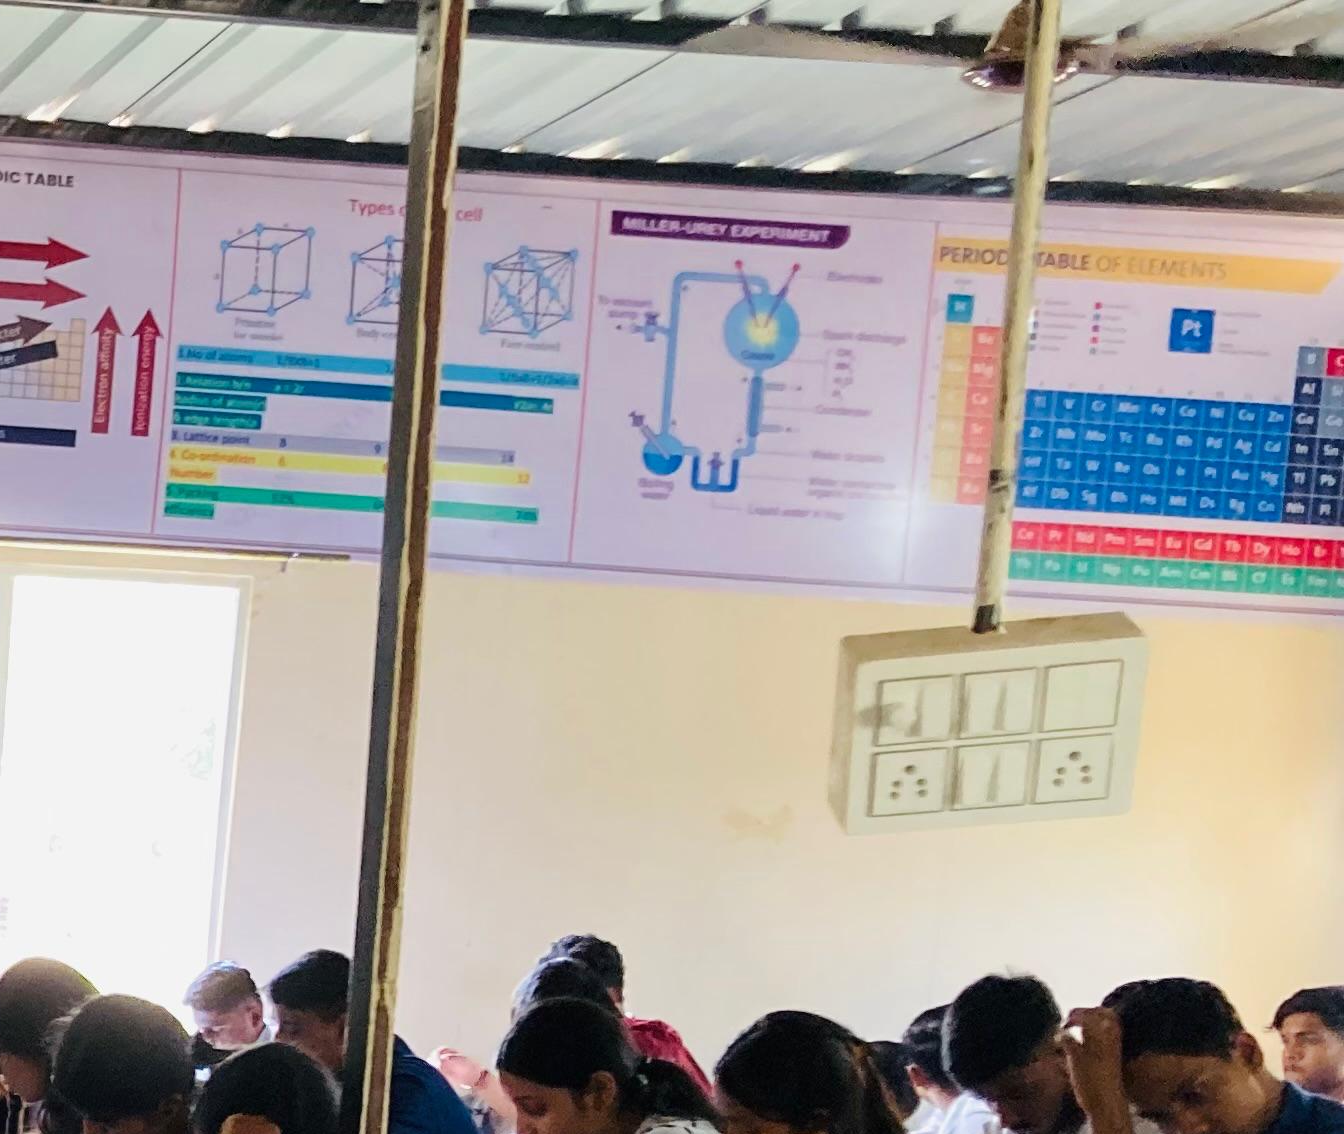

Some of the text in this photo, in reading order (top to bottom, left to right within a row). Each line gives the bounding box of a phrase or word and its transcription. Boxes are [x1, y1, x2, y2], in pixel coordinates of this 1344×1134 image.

[26, 172, 74, 188] TABLE
[349, 199, 482, 222] Types cell
[622, 216, 831, 243] MILLER-UREY EXPERIMENT
[940, 246, 1227, 280] PERIOD TABLE OF ELEMENTS
[94, 327, 113, 424] Electron affinity
[133, 325, 154, 432] Ionization energy
